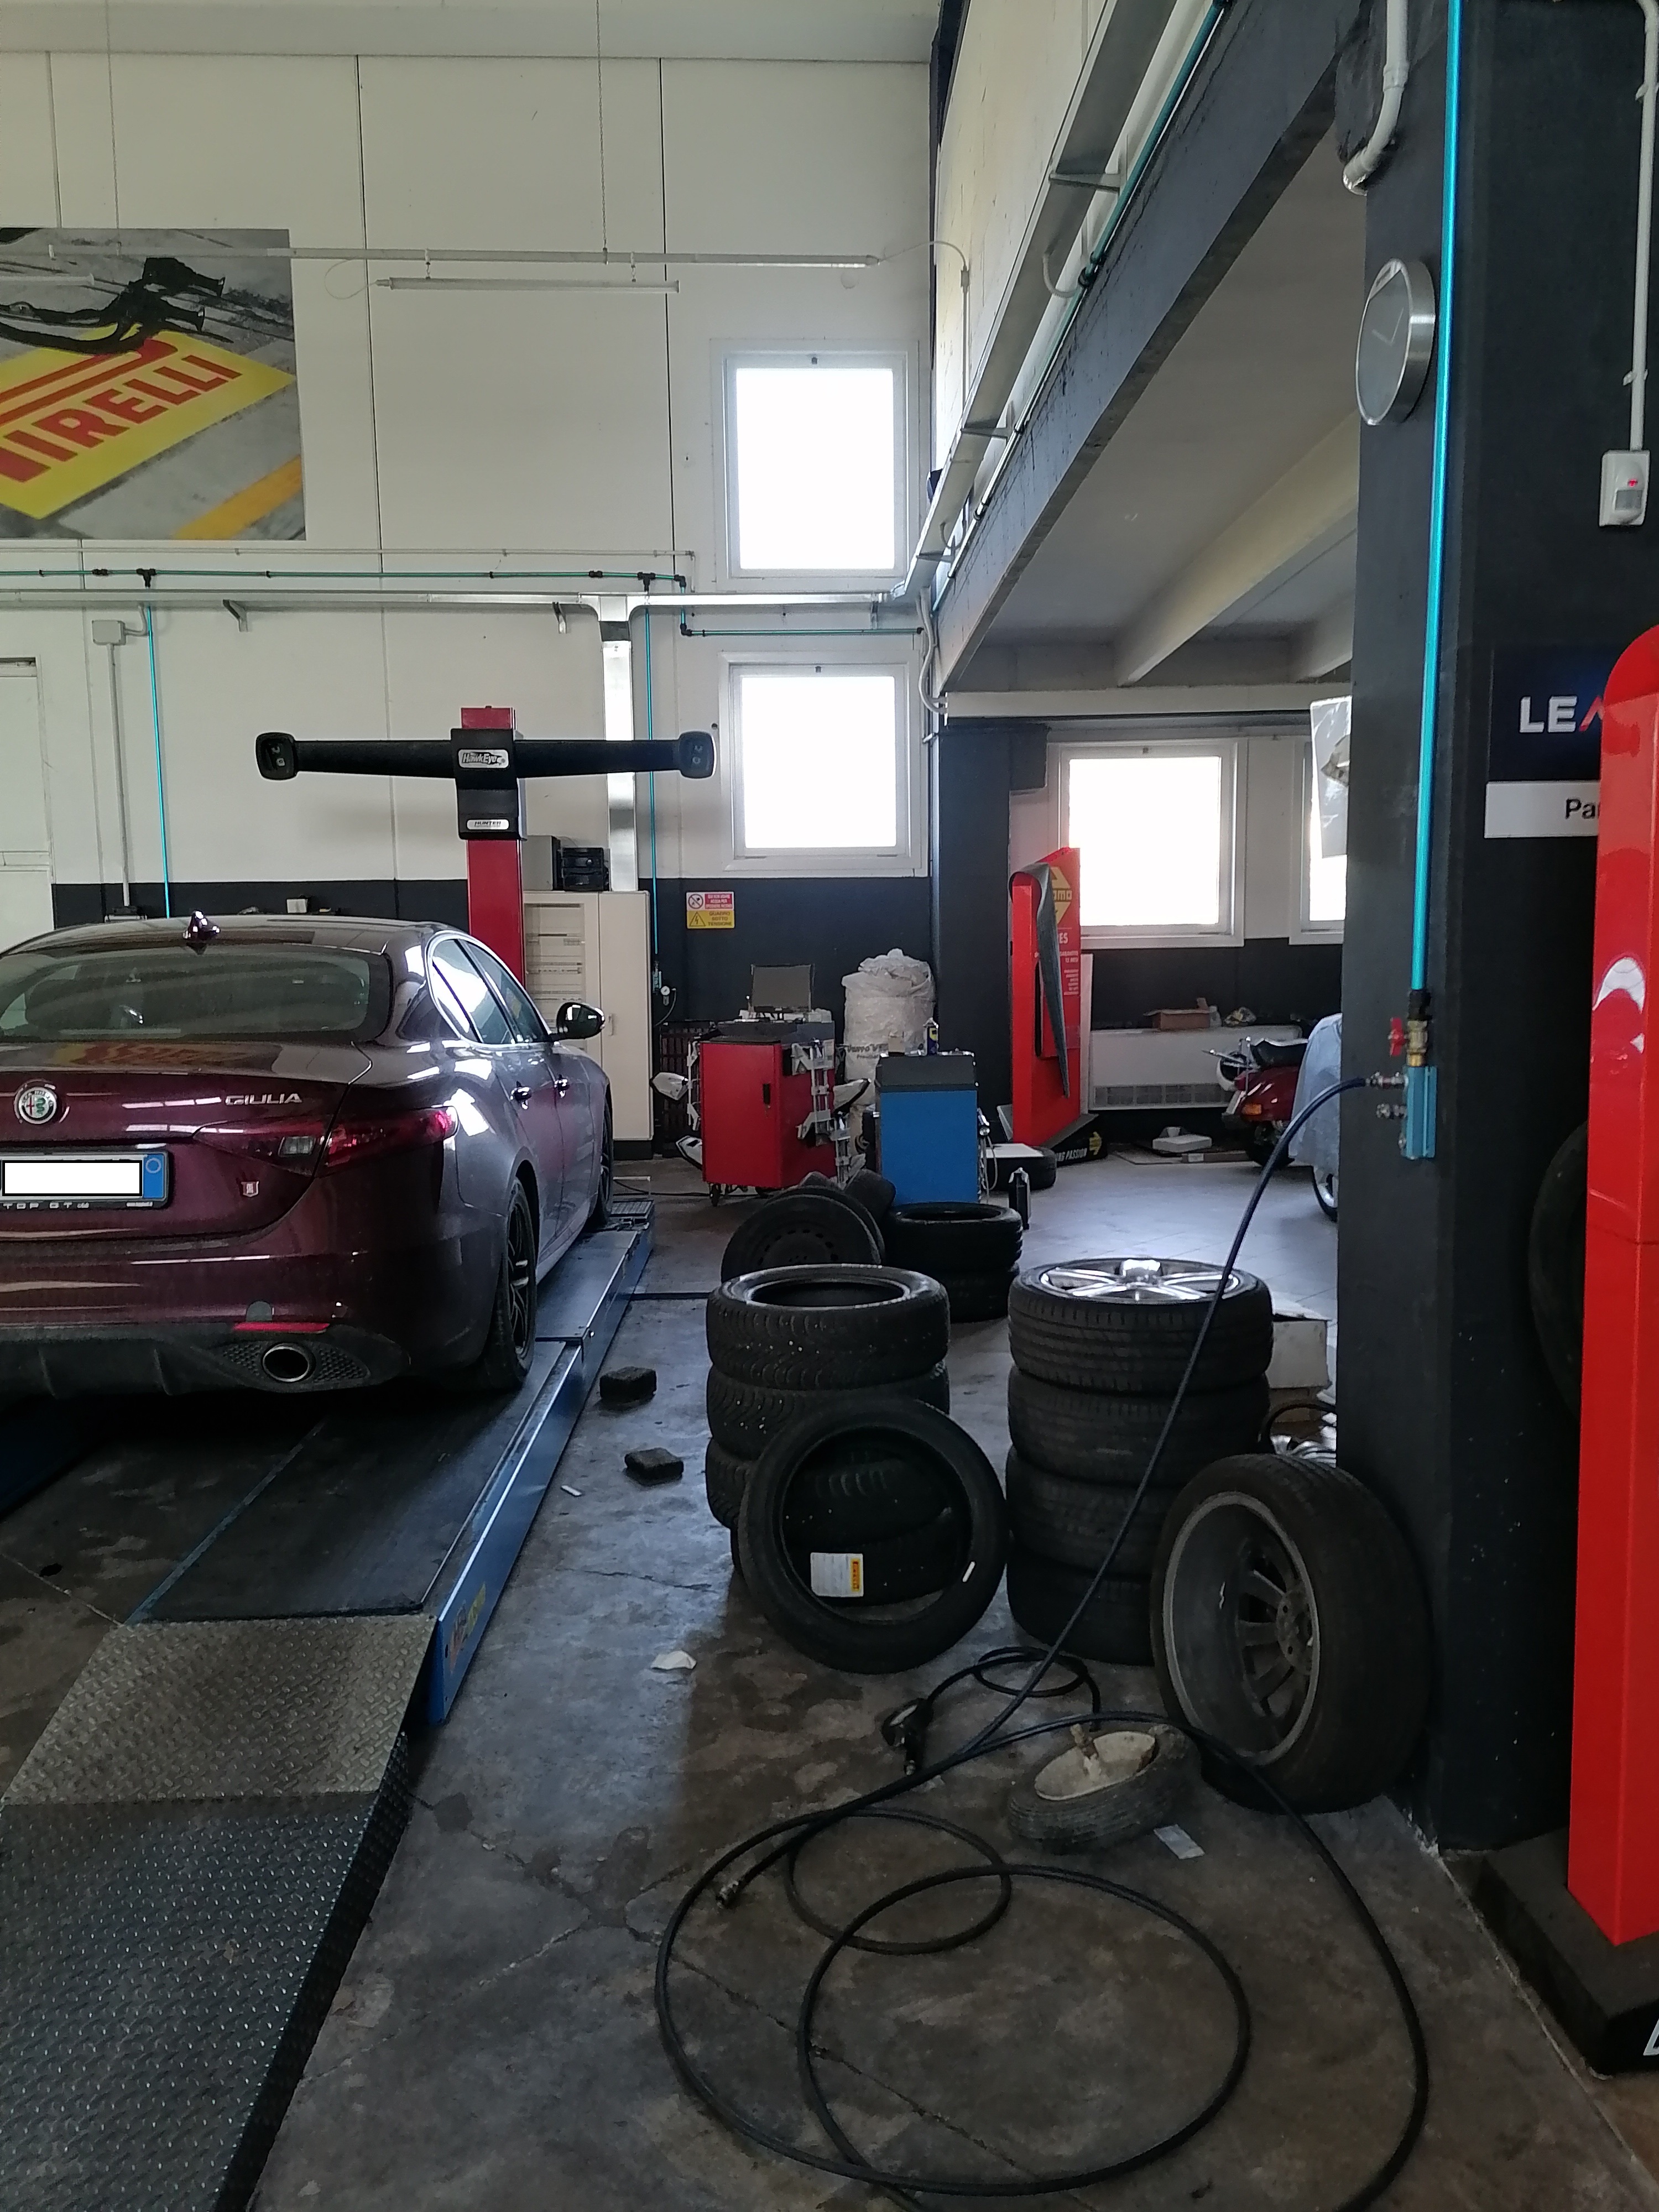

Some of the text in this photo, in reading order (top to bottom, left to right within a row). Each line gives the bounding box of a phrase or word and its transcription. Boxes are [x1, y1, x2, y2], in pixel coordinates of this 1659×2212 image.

[1520, 696, 1603, 733] LEA
[1566, 799, 1599, 820] Pa
[225, 1093, 302, 1105] GIULIA
